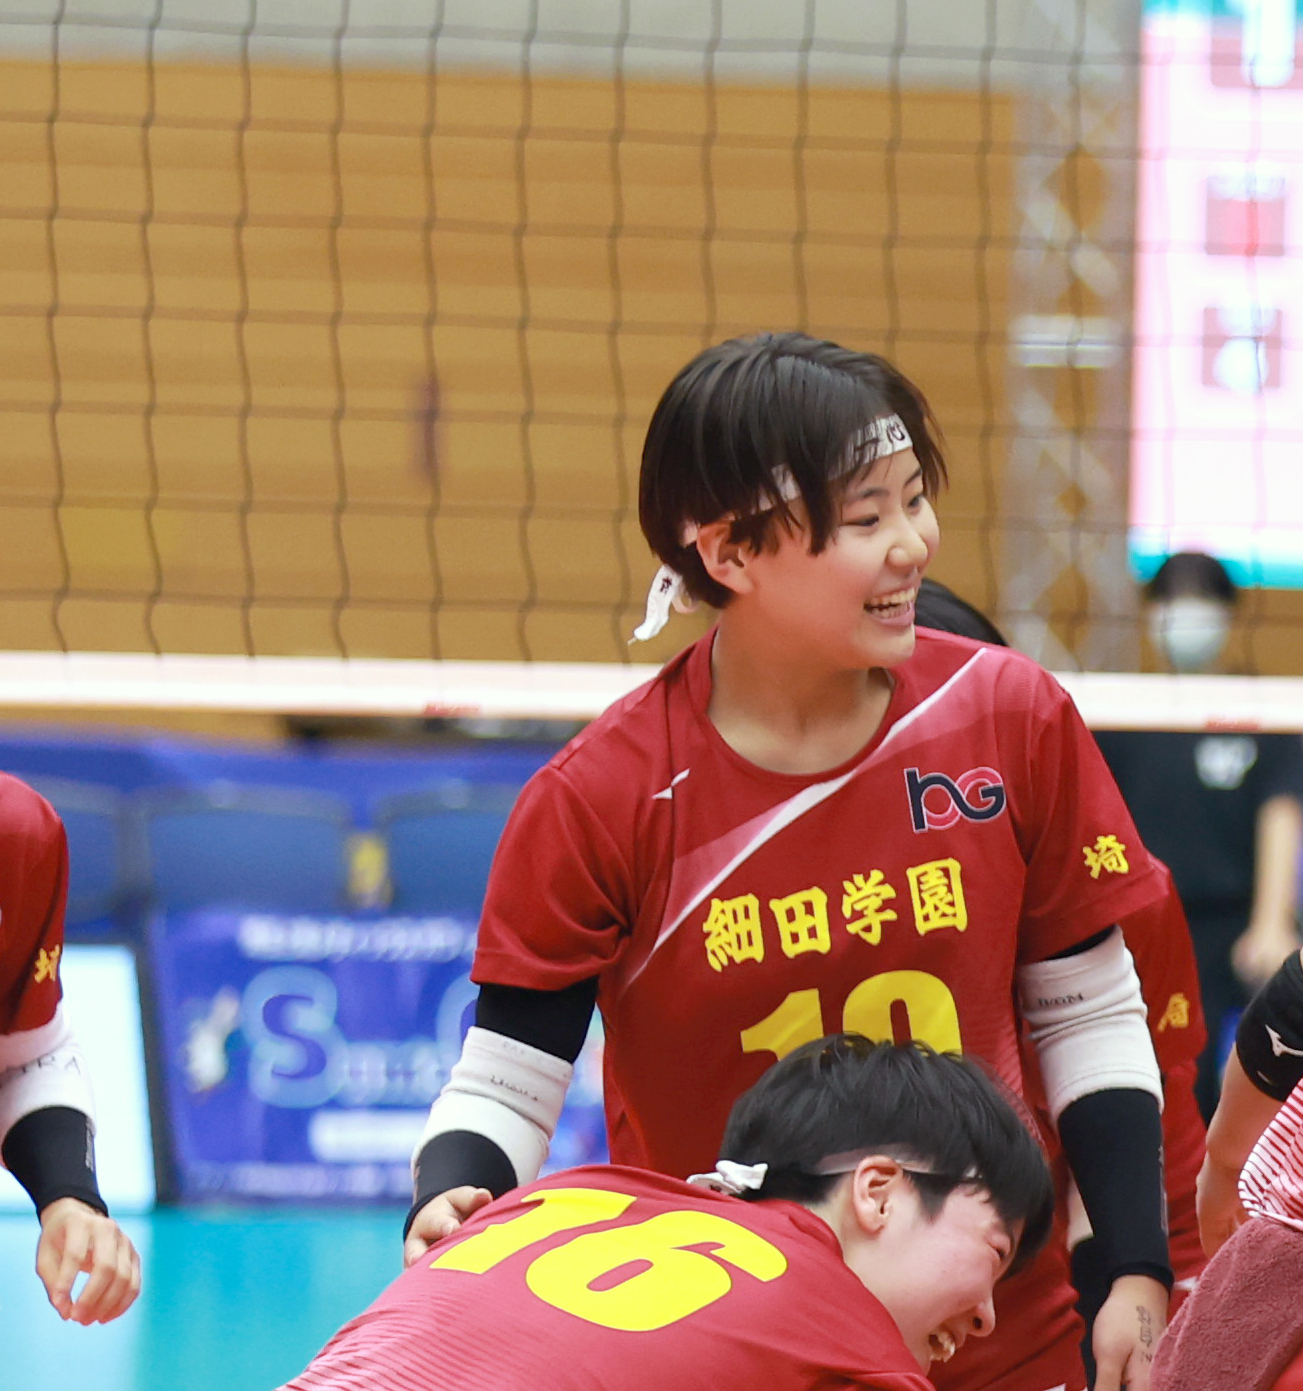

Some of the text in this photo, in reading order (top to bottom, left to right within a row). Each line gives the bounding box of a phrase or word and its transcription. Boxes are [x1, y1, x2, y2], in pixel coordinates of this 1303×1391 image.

[703, 857, 968, 972] 細田学園
[1083, 834, 1130, 880] 埼
[430, 1187, 788, 1332] 16
